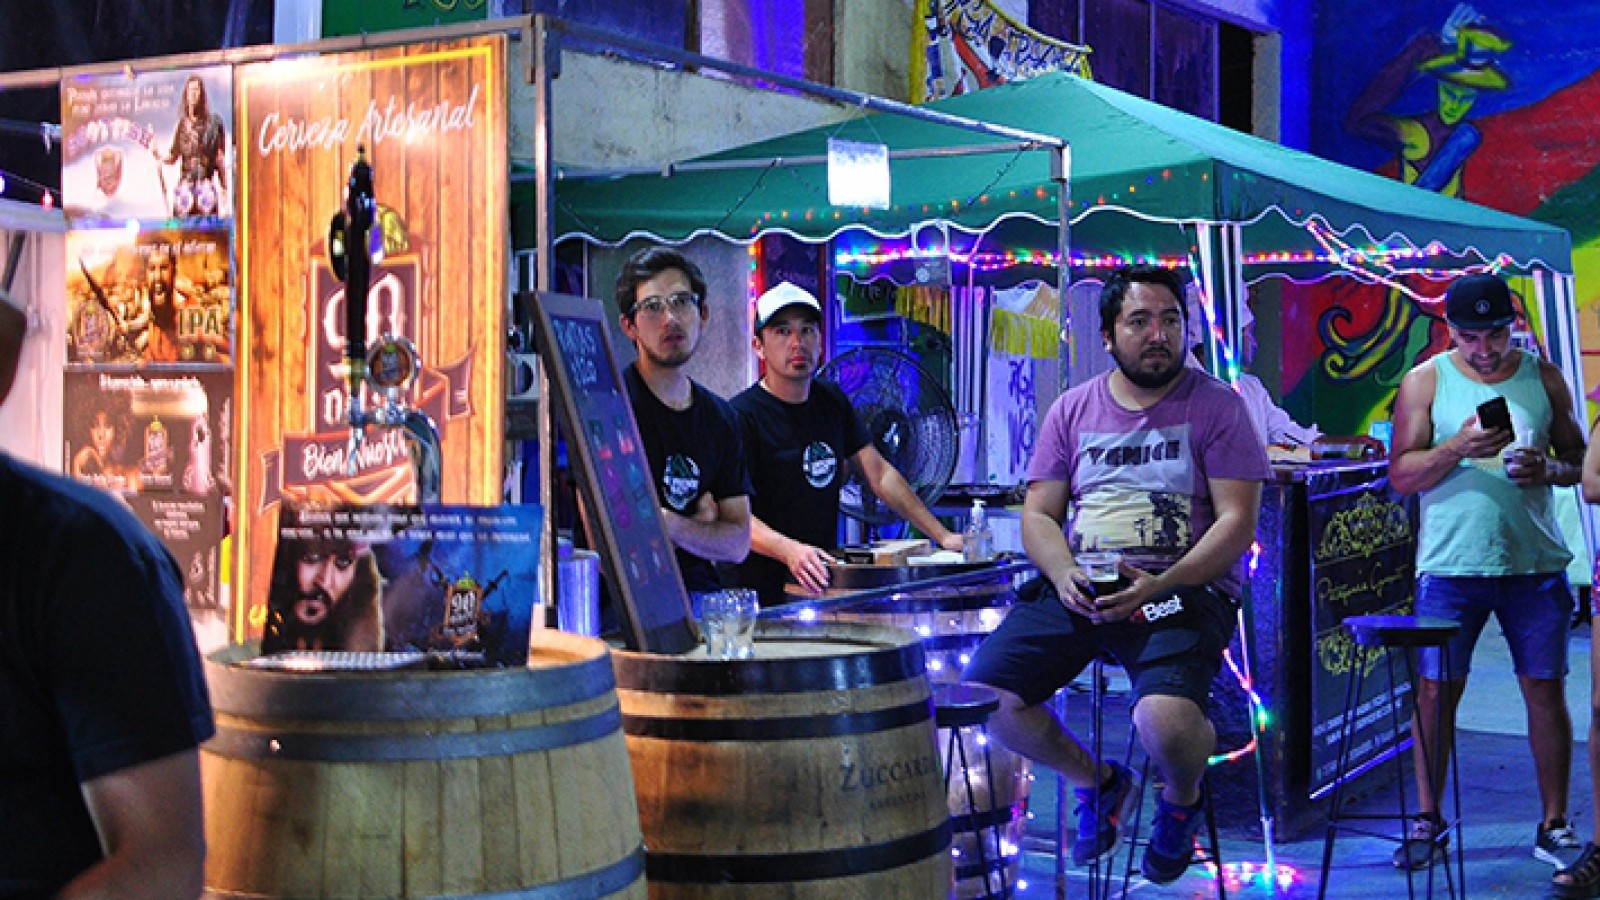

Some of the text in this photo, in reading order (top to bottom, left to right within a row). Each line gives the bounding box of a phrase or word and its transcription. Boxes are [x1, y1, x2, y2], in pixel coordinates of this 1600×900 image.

[259, 83, 481, 157] Cerveza Artesanal
[179, 307, 220, 336] IPA
